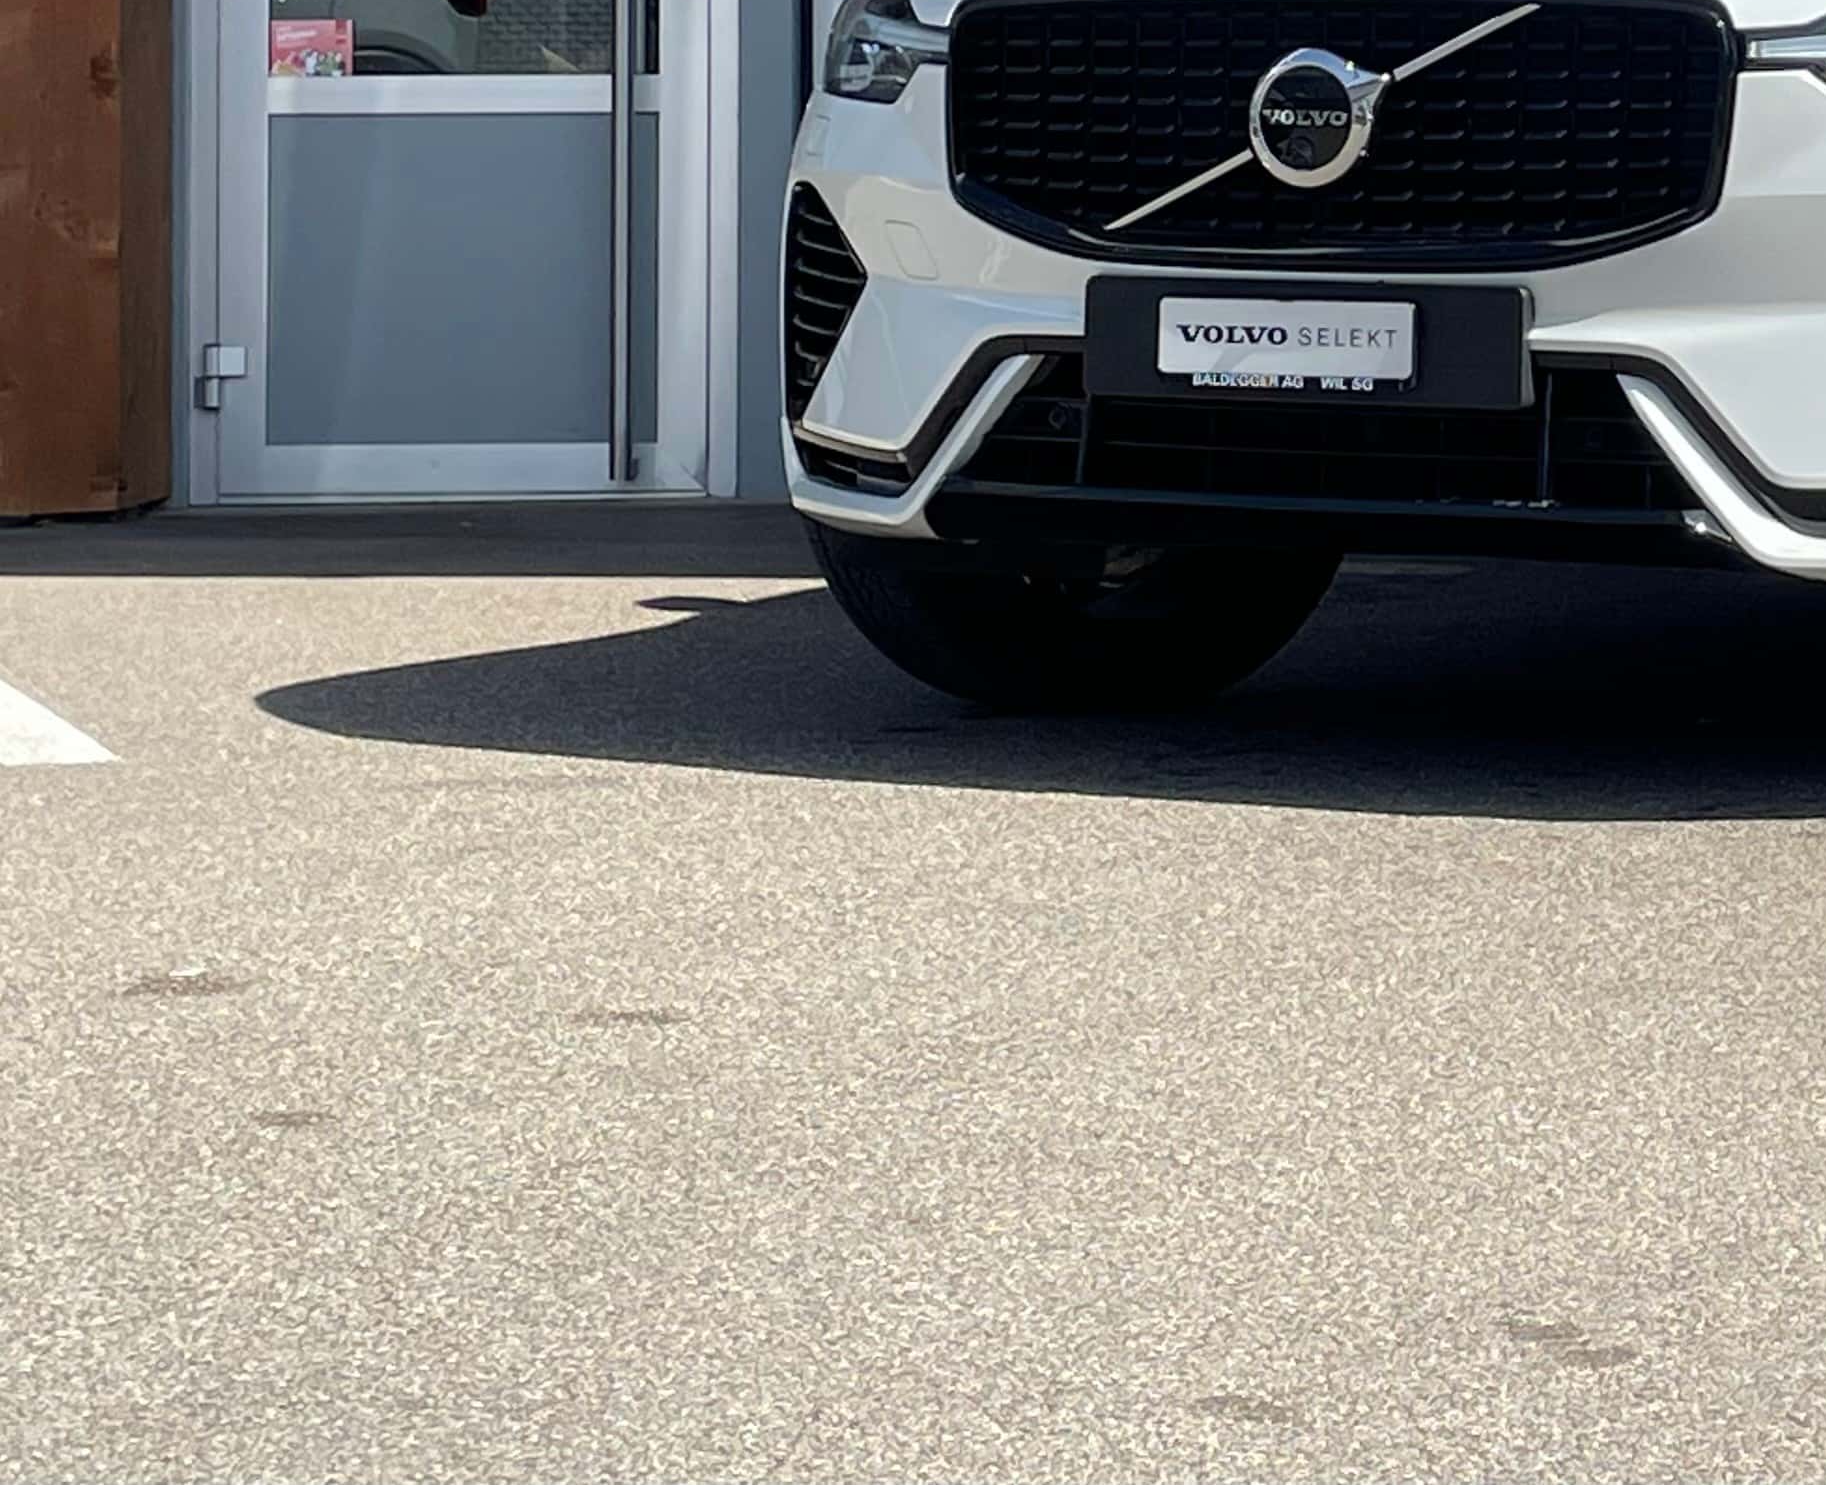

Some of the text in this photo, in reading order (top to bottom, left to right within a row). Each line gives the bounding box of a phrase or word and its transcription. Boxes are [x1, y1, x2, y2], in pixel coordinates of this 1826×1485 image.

[1262, 108, 1347, 126] VOLVO
[1176, 324, 1398, 348] VOLVO SELEKT
[1320, 377, 1348, 390] WIL
[1351, 378, 1374, 391] SG
